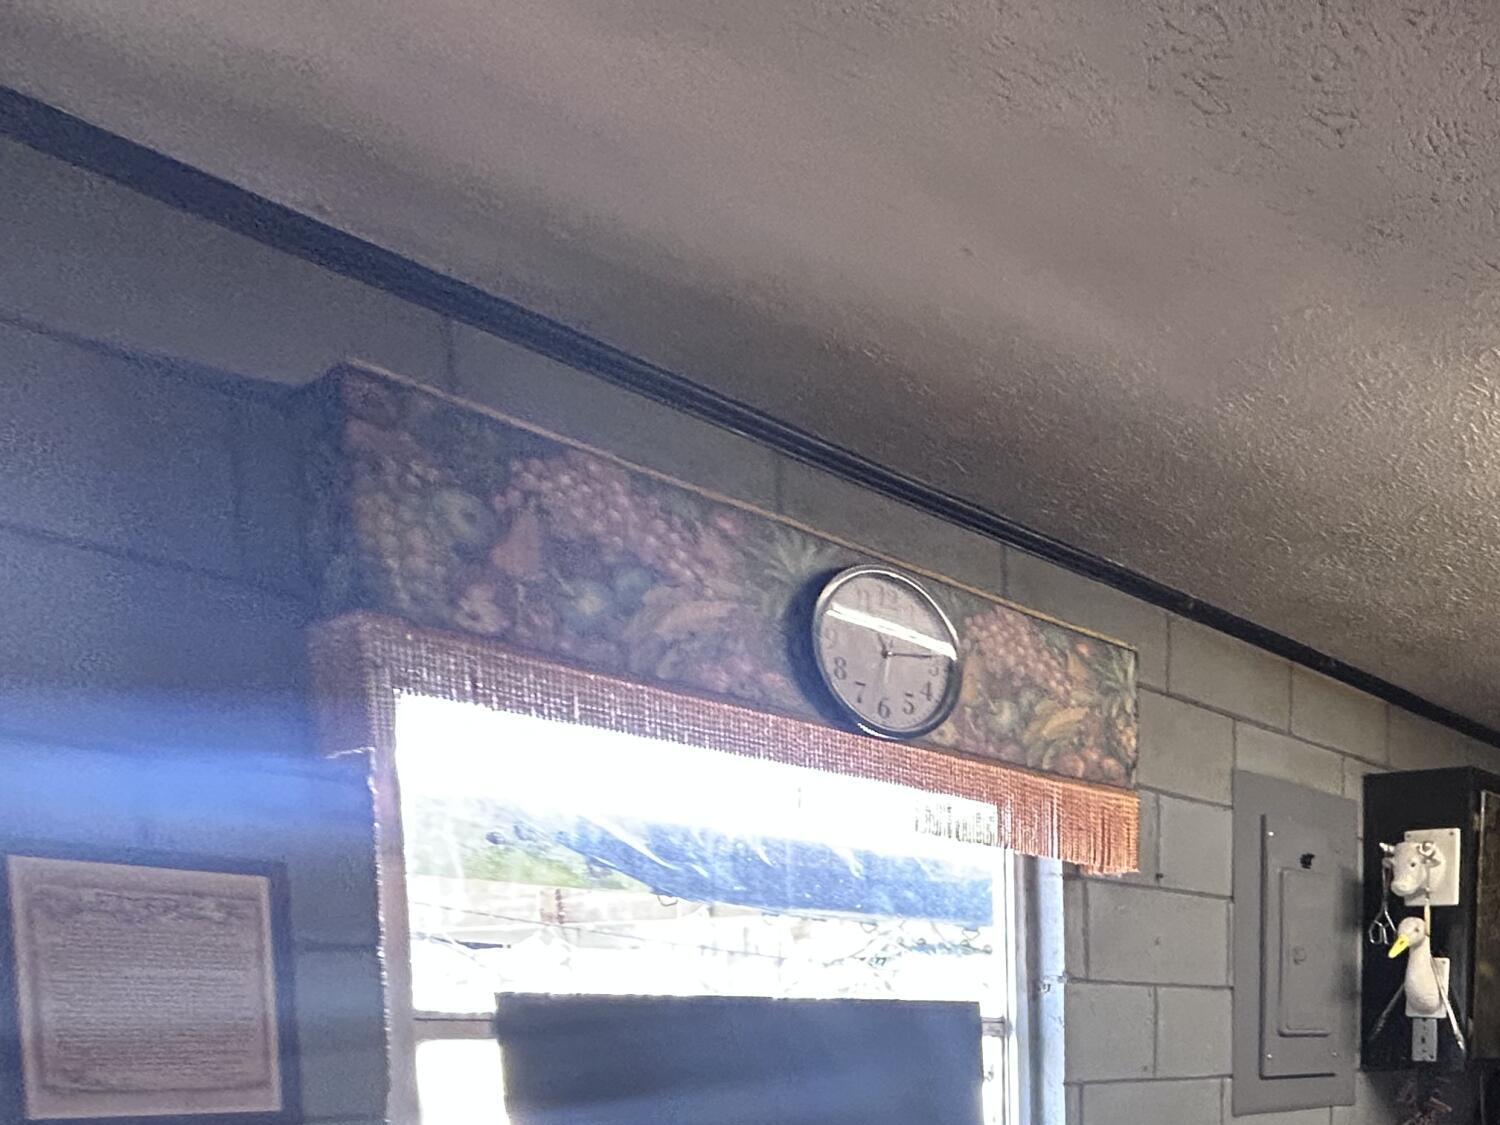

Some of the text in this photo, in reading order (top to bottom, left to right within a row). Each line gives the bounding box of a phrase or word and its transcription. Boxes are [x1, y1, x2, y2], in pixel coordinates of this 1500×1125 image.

[833, 656, 847, 680] 8
[854, 680, 866, 704] 7
[919, 681, 933, 702] 4
[877, 699, 891, 719] 6
[903, 692, 915, 715] 5
